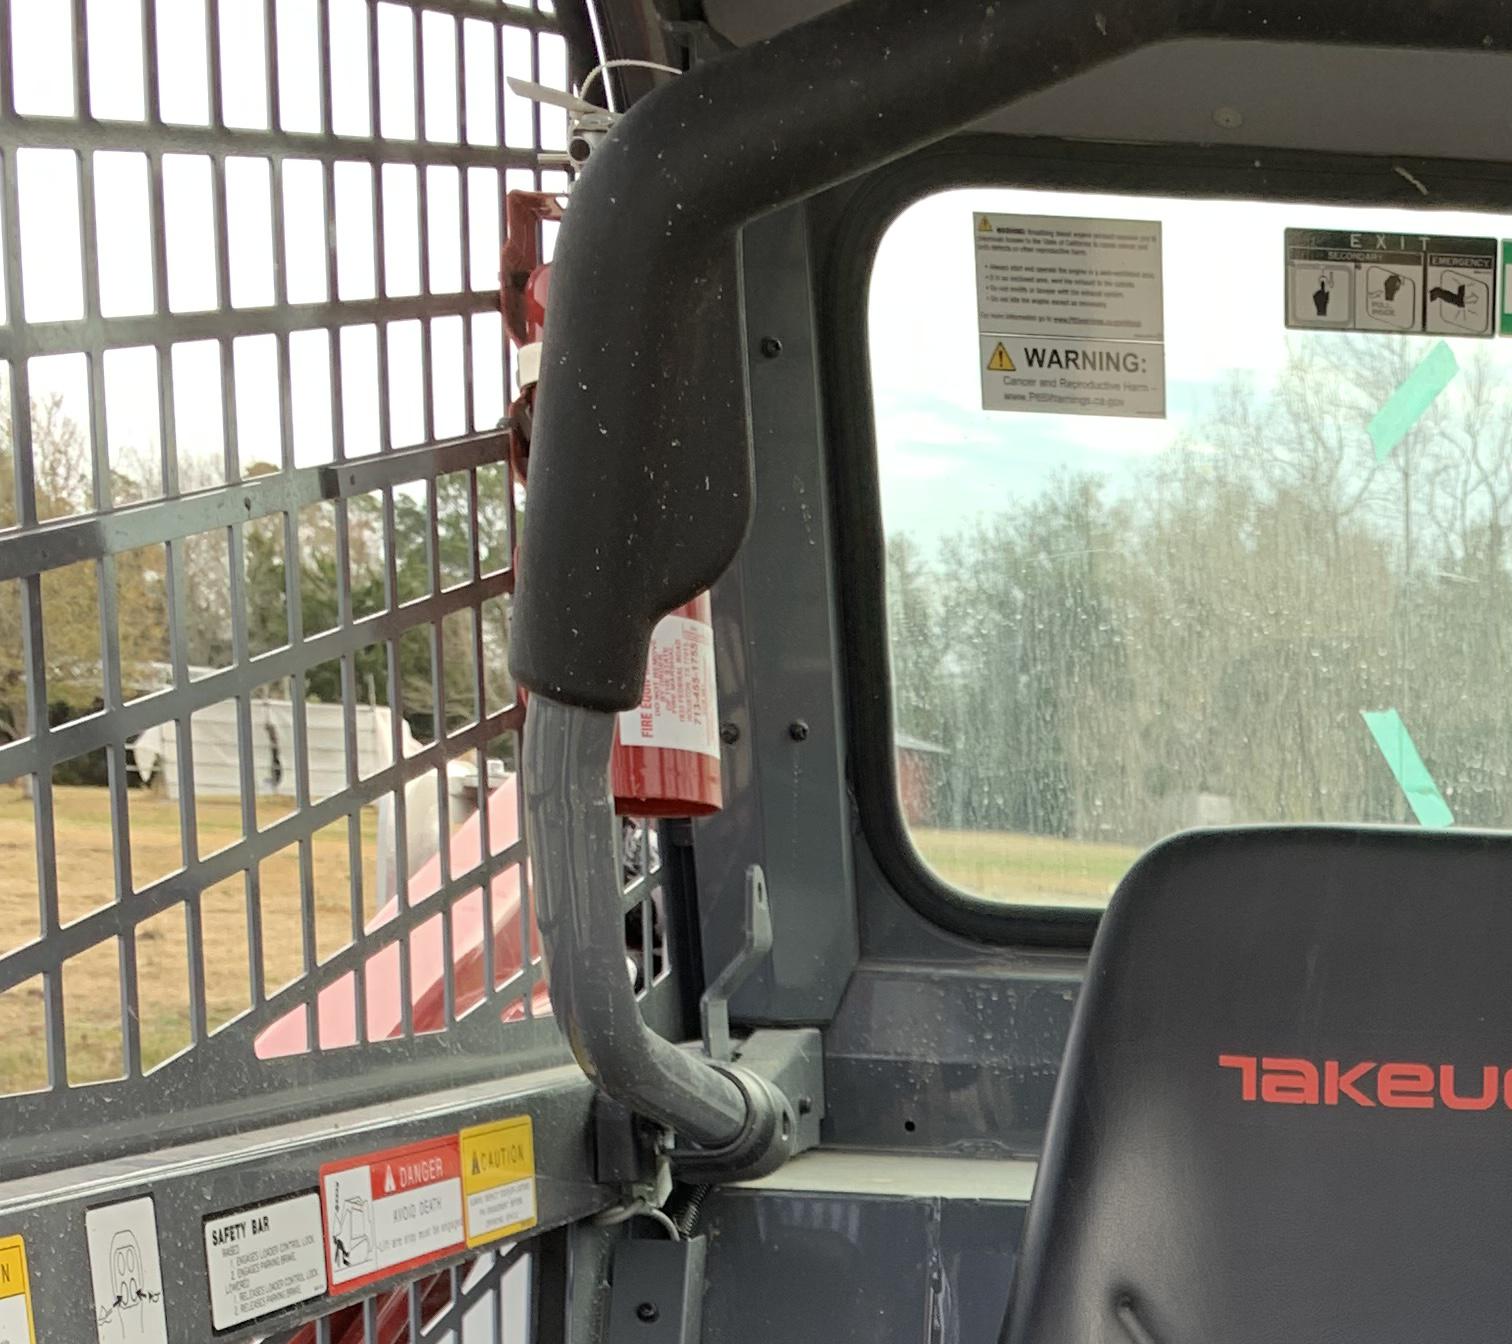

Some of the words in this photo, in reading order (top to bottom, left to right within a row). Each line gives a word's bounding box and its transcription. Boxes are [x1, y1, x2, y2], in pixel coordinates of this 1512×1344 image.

[1350, 233, 1430, 250] EXIT
[1432, 257, 1491, 267] EMERGENCY
[1024, 347, 1147, 374] WARNING:
[1003, 376, 1036, 387] Cancer
[1040, 379, 1056, 387] and
[1060, 378, 1121, 391] Reproductive
[640, 713, 654, 738] FIRE
[480, 1144, 525, 1171] CAUTION
[400, 1158, 444, 1188] DANGER
[212, 1221, 246, 1246] SAFETY
[252, 1216, 269, 1235] BAR
